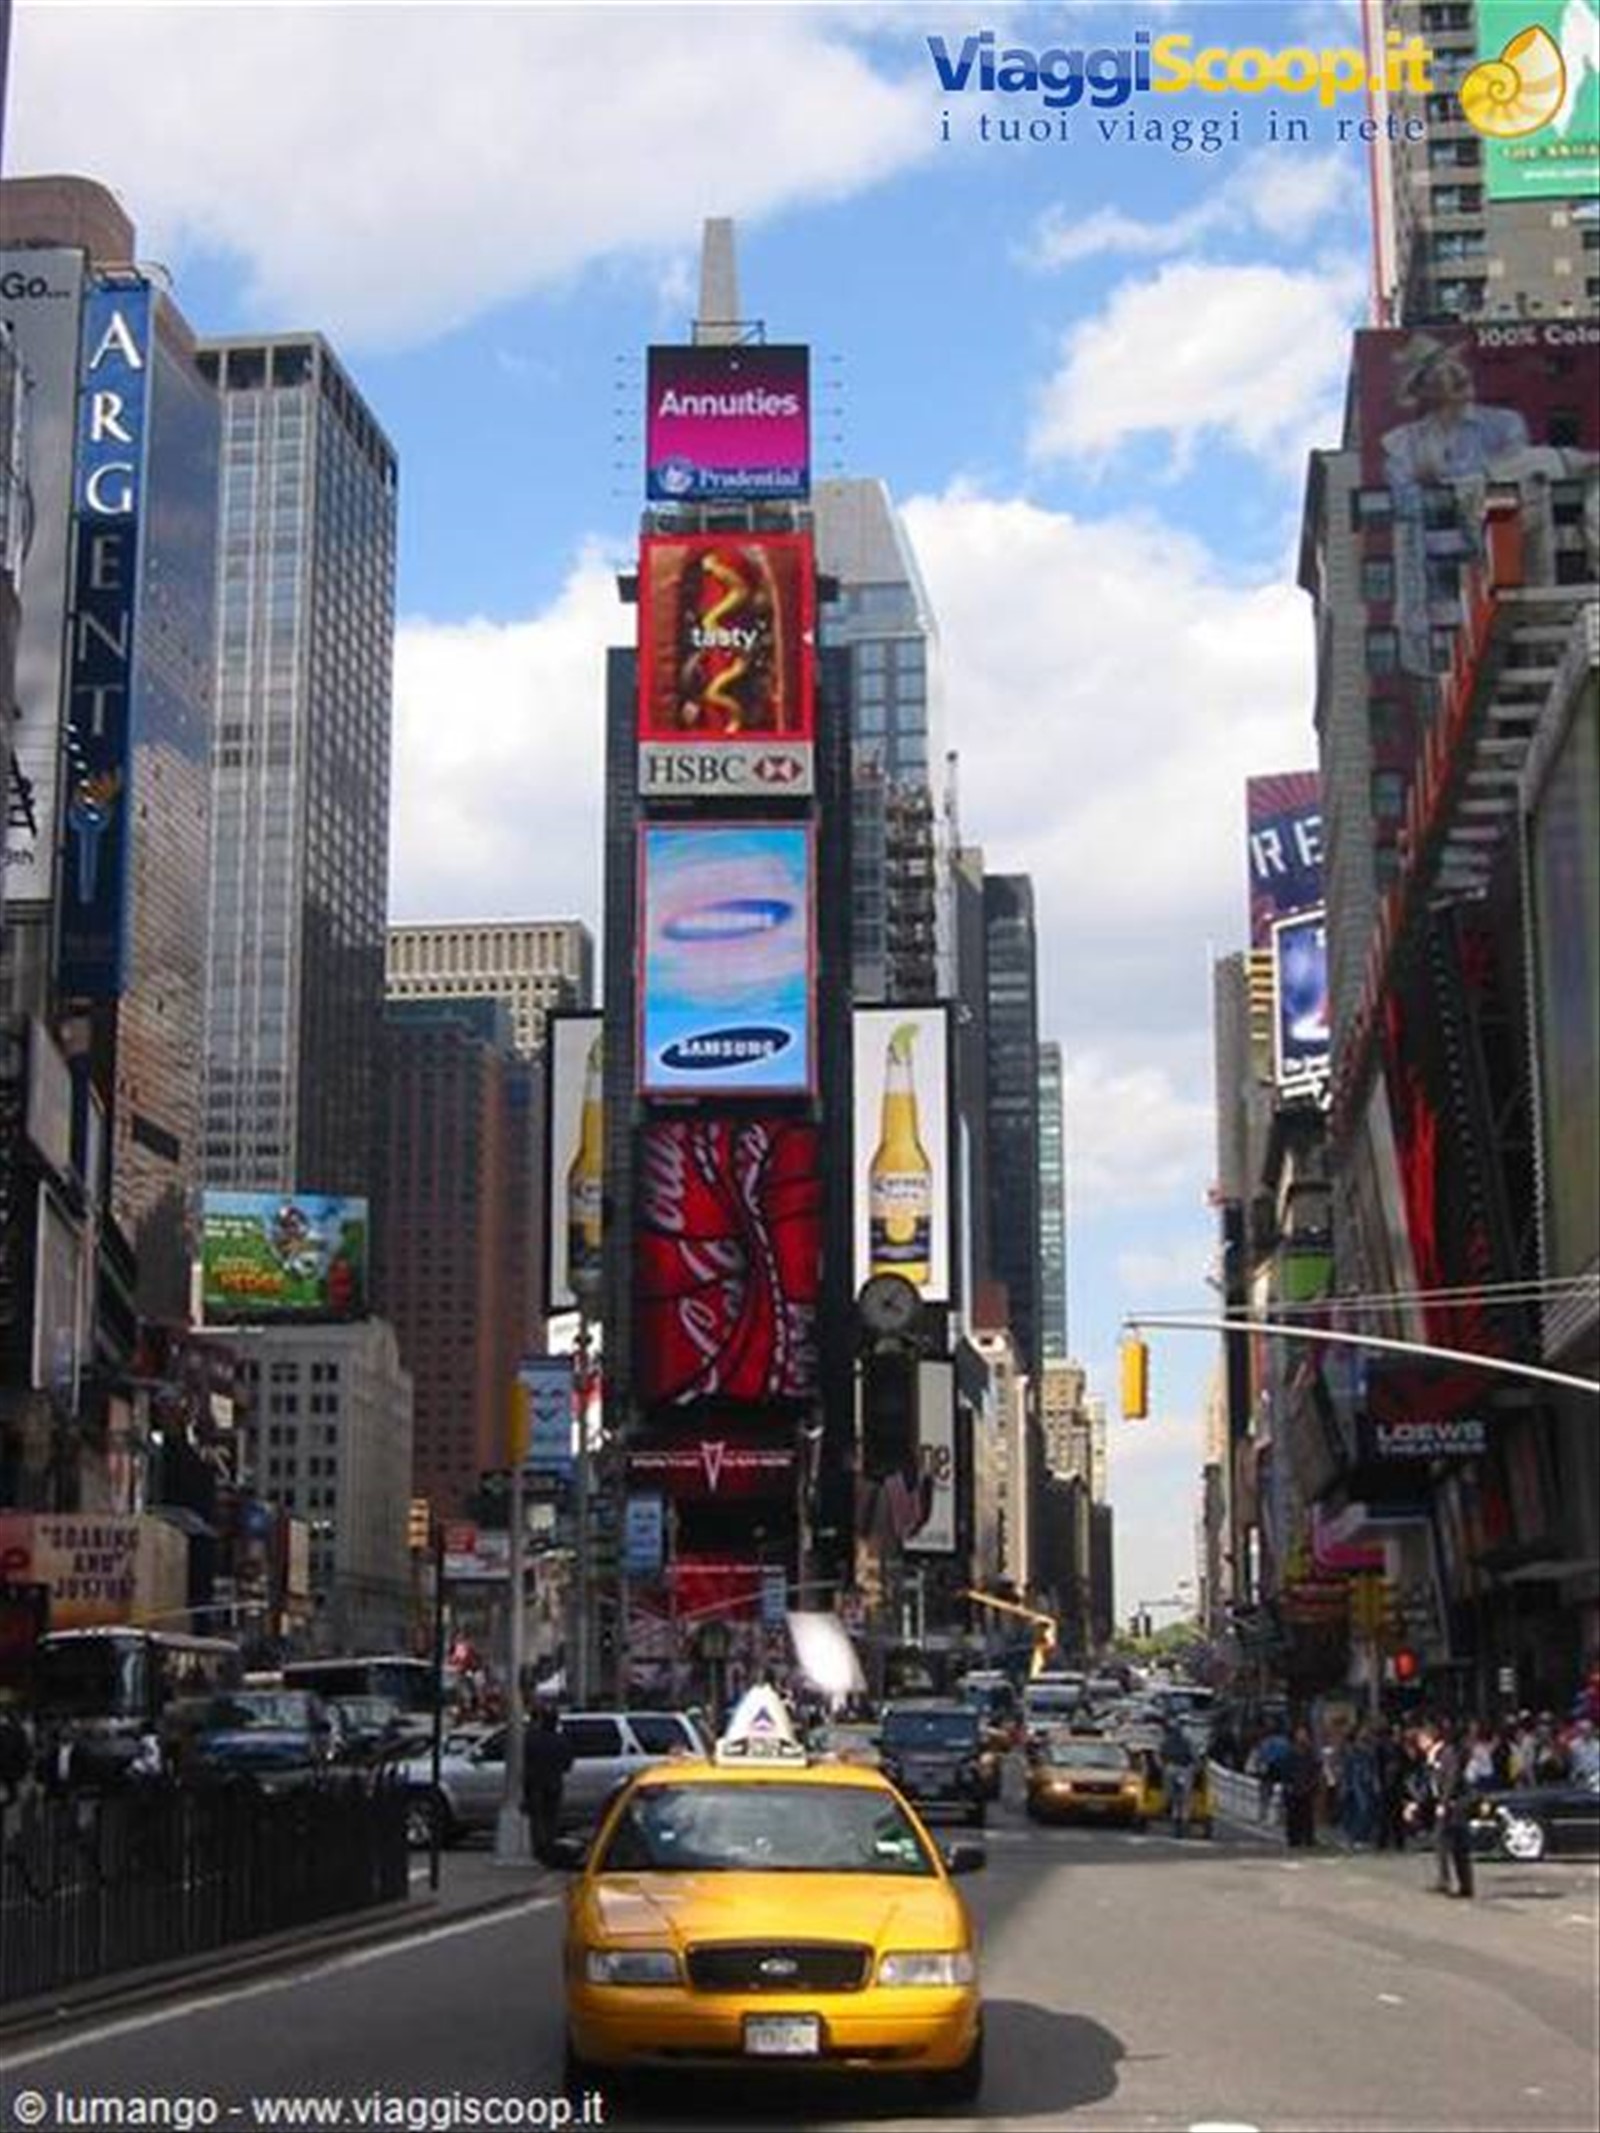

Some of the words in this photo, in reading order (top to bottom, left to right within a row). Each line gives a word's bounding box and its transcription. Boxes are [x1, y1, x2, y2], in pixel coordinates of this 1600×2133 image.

[658, 388, 801, 417] Annuities
[76, 310, 143, 736] ARGENT
[691, 627, 758, 650] tasty
[648, 755, 748, 785] HSBC
[678, 1038, 776, 1058] SAMSUNG
[1376, 1420, 1486, 1441] LOEWS
